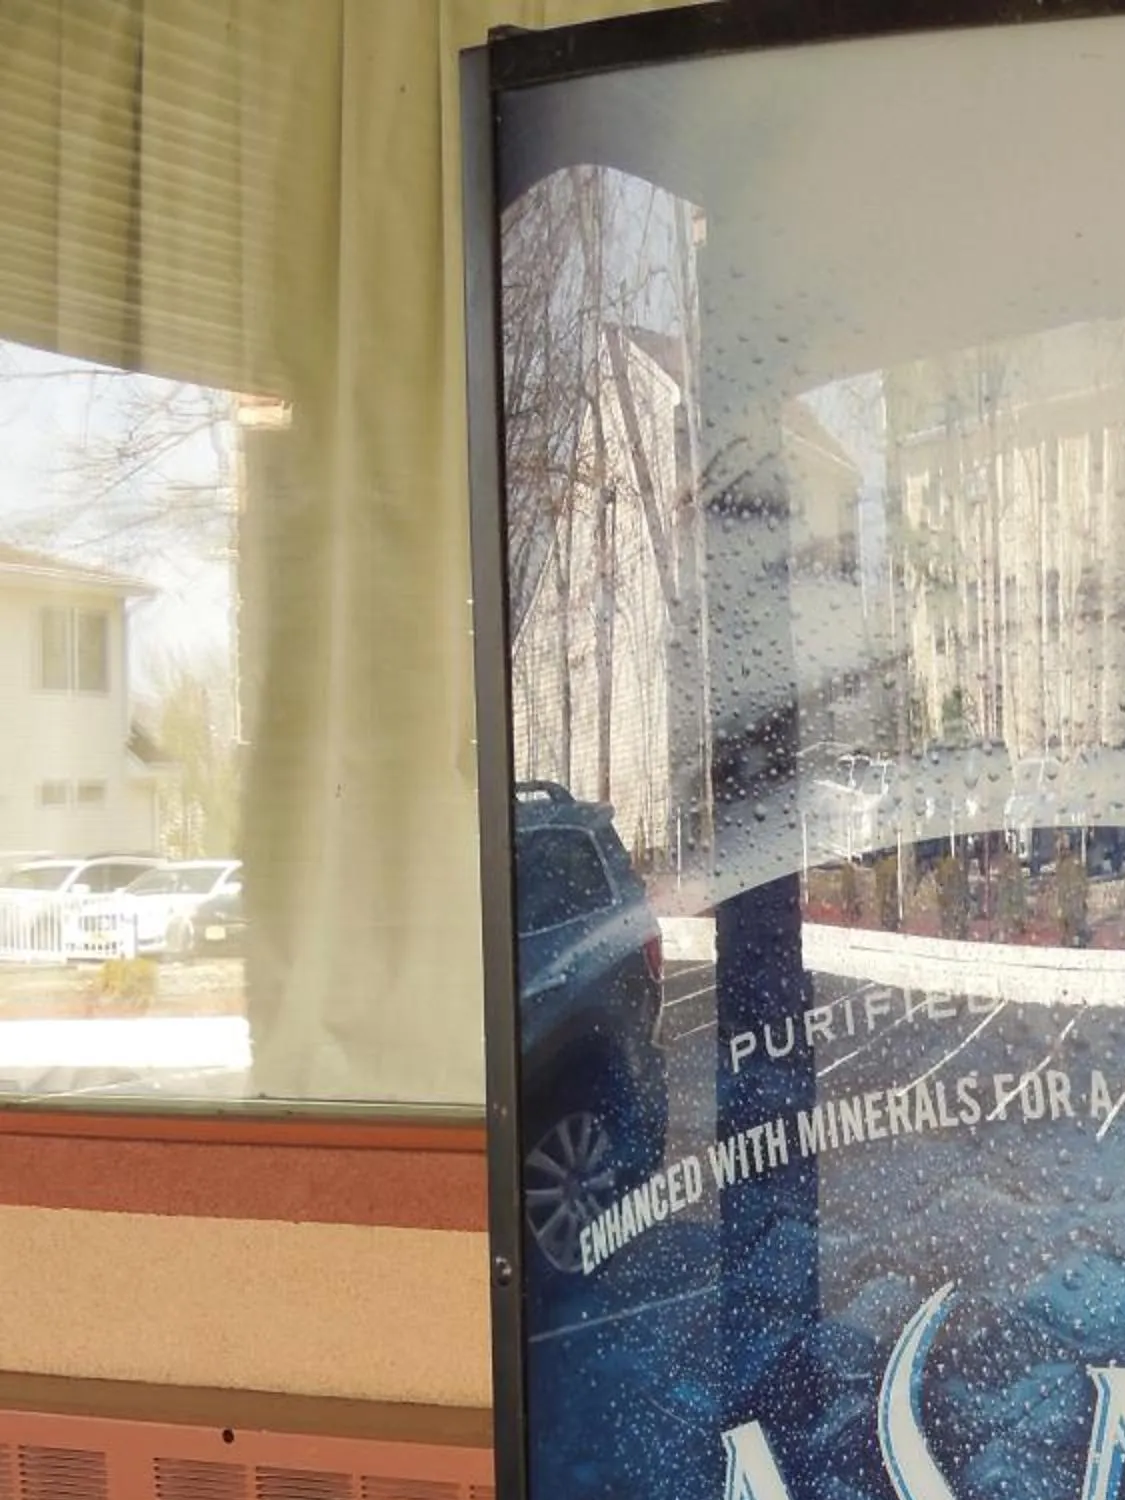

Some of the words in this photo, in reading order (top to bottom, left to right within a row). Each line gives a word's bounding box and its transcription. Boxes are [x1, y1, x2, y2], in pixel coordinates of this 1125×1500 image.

[579, 1155, 702, 1276] ENHANCED
[706, 1118, 790, 1190] WITH
[797, 1074, 981, 1158] MINERALS
[994, 1070, 1074, 1121] FOR
[1086, 1070, 1114, 1120] A
